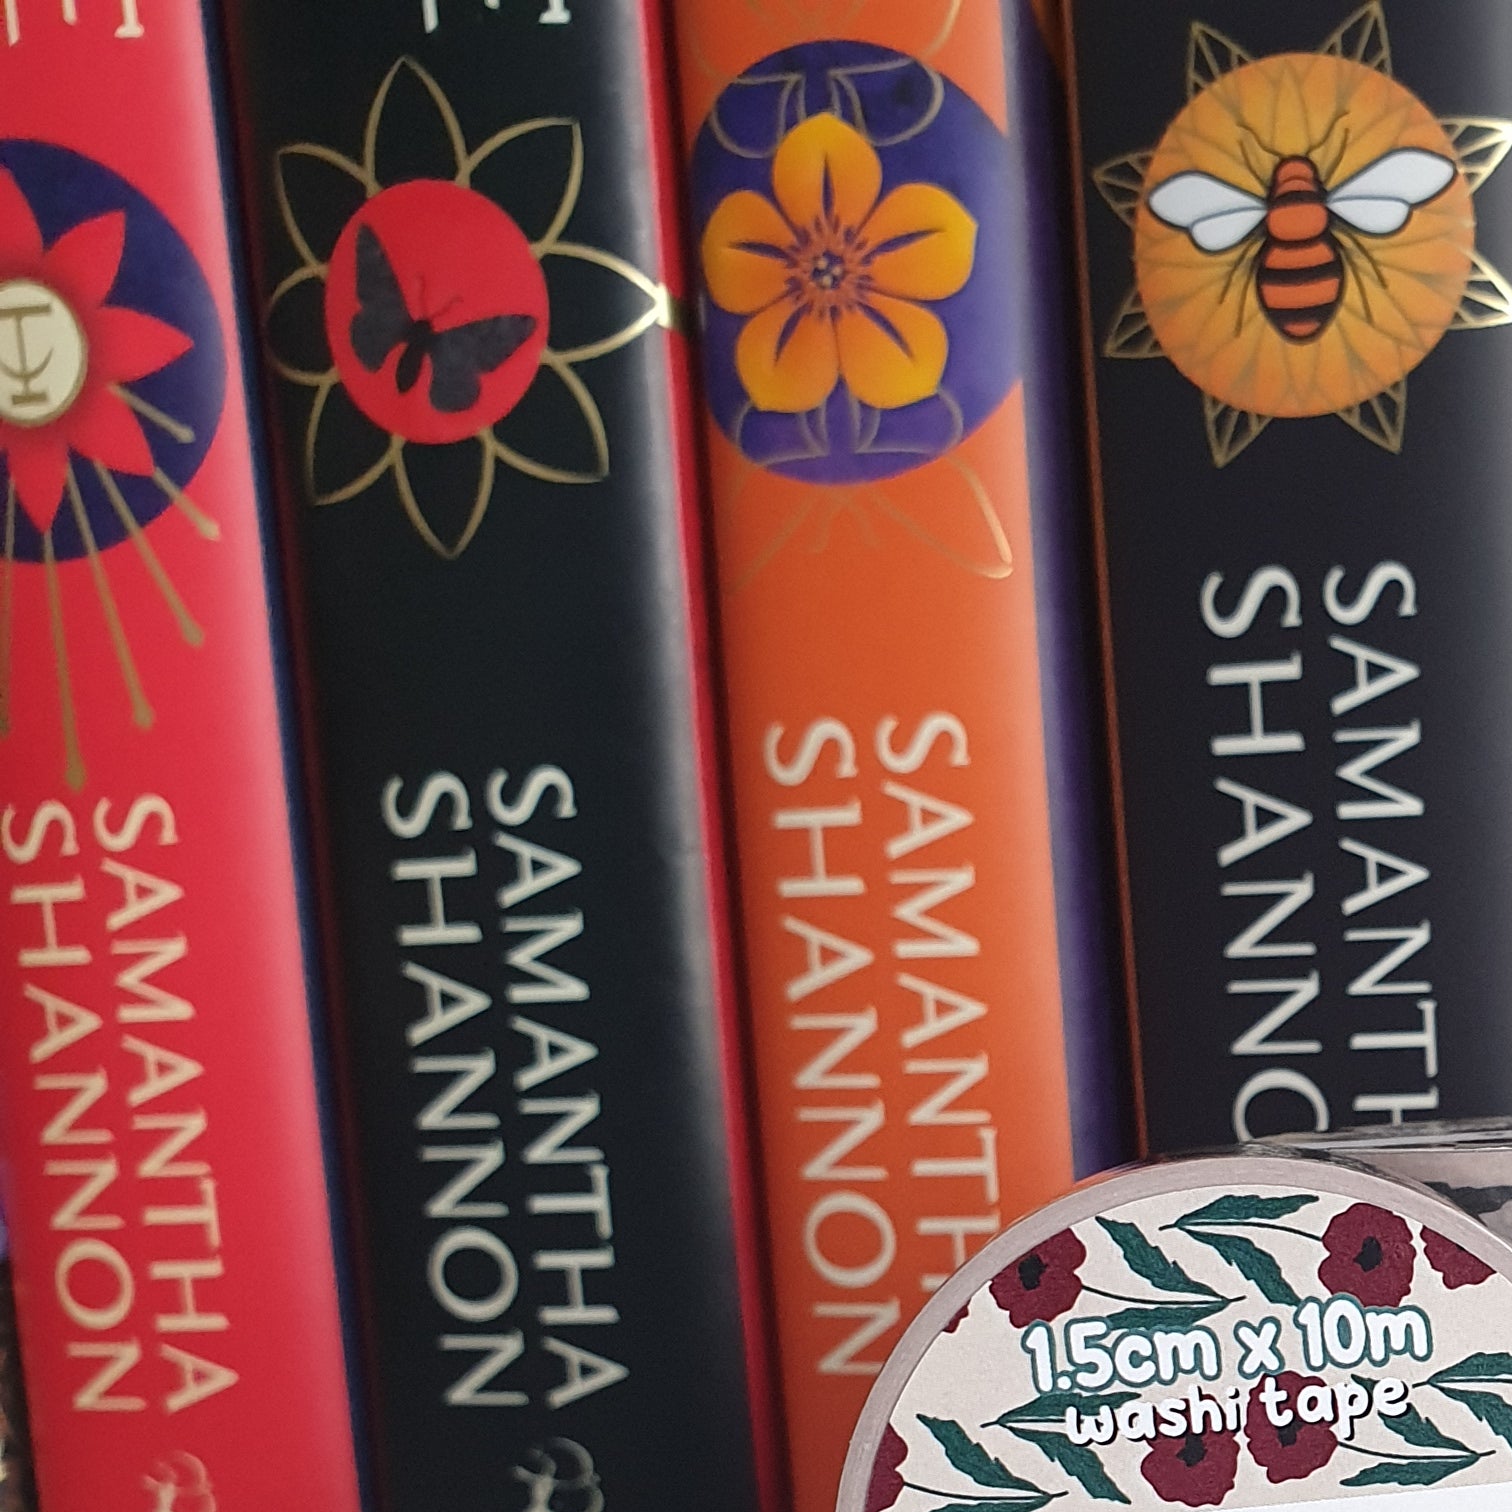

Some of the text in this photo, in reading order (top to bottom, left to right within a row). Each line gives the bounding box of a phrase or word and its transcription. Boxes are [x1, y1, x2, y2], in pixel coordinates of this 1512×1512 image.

[2, 800, 146, 1413] SHANNON
[92, 792, 240, 1414] SAMANTHA
[382, 770, 530, 1410] SHANNON
[486, 763, 630, 1411] SAMANTHA
[763, 714, 900, 1375] SHANNON
[874, 710, 1000, 1292] SAMANTH
[1201, 565, 1330, 1143] SHANNO
[1323, 560, 1440, 1127] SAMANT
[1022, 1319, 1220, 1394] 1.5cm
[1294, 1293, 1432, 1370] 10m
[1066, 1368, 1409, 1445] washi tape
